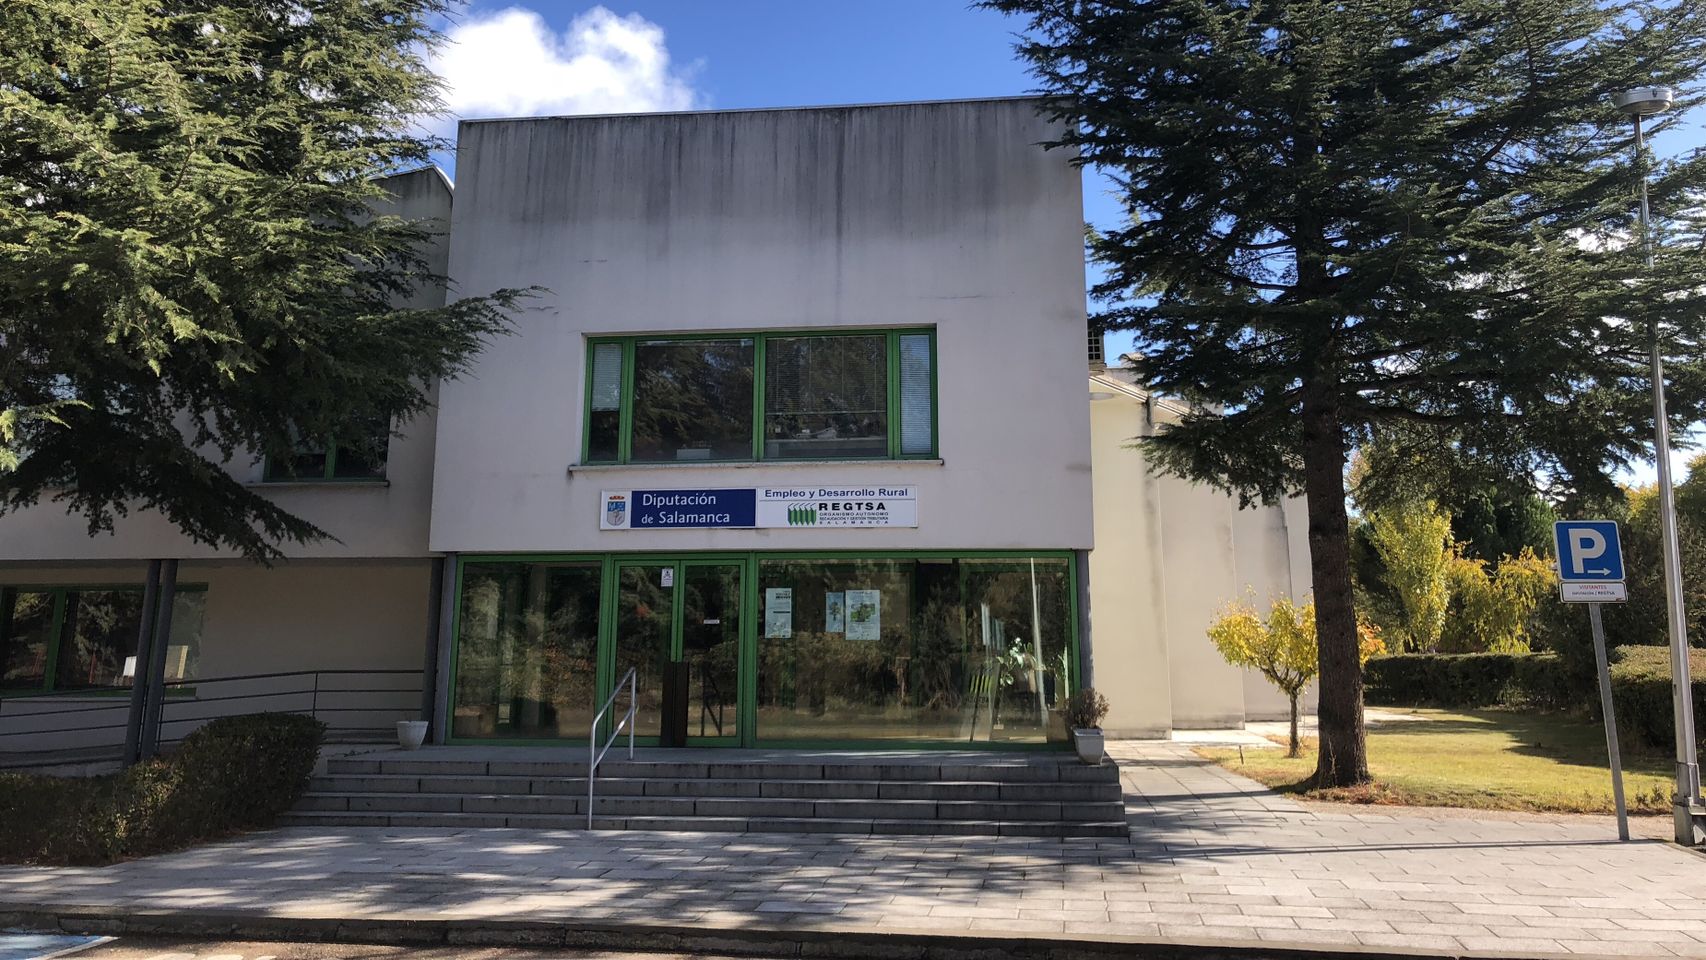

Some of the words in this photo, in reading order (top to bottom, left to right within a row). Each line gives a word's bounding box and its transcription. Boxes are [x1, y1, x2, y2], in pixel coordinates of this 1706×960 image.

[642, 492, 716, 508] Diputación
[765, 489, 806, 499] Empleo
[809, 490, 816, 499] y
[818, 488, 874, 498] Desarrollo
[878, 488, 908, 497] Rural
[818, 502, 886, 511] REGTSA
[641, 513, 654, 524] de
[658, 510, 730, 524] Salamanca
[1568, 528, 1607, 574] P
